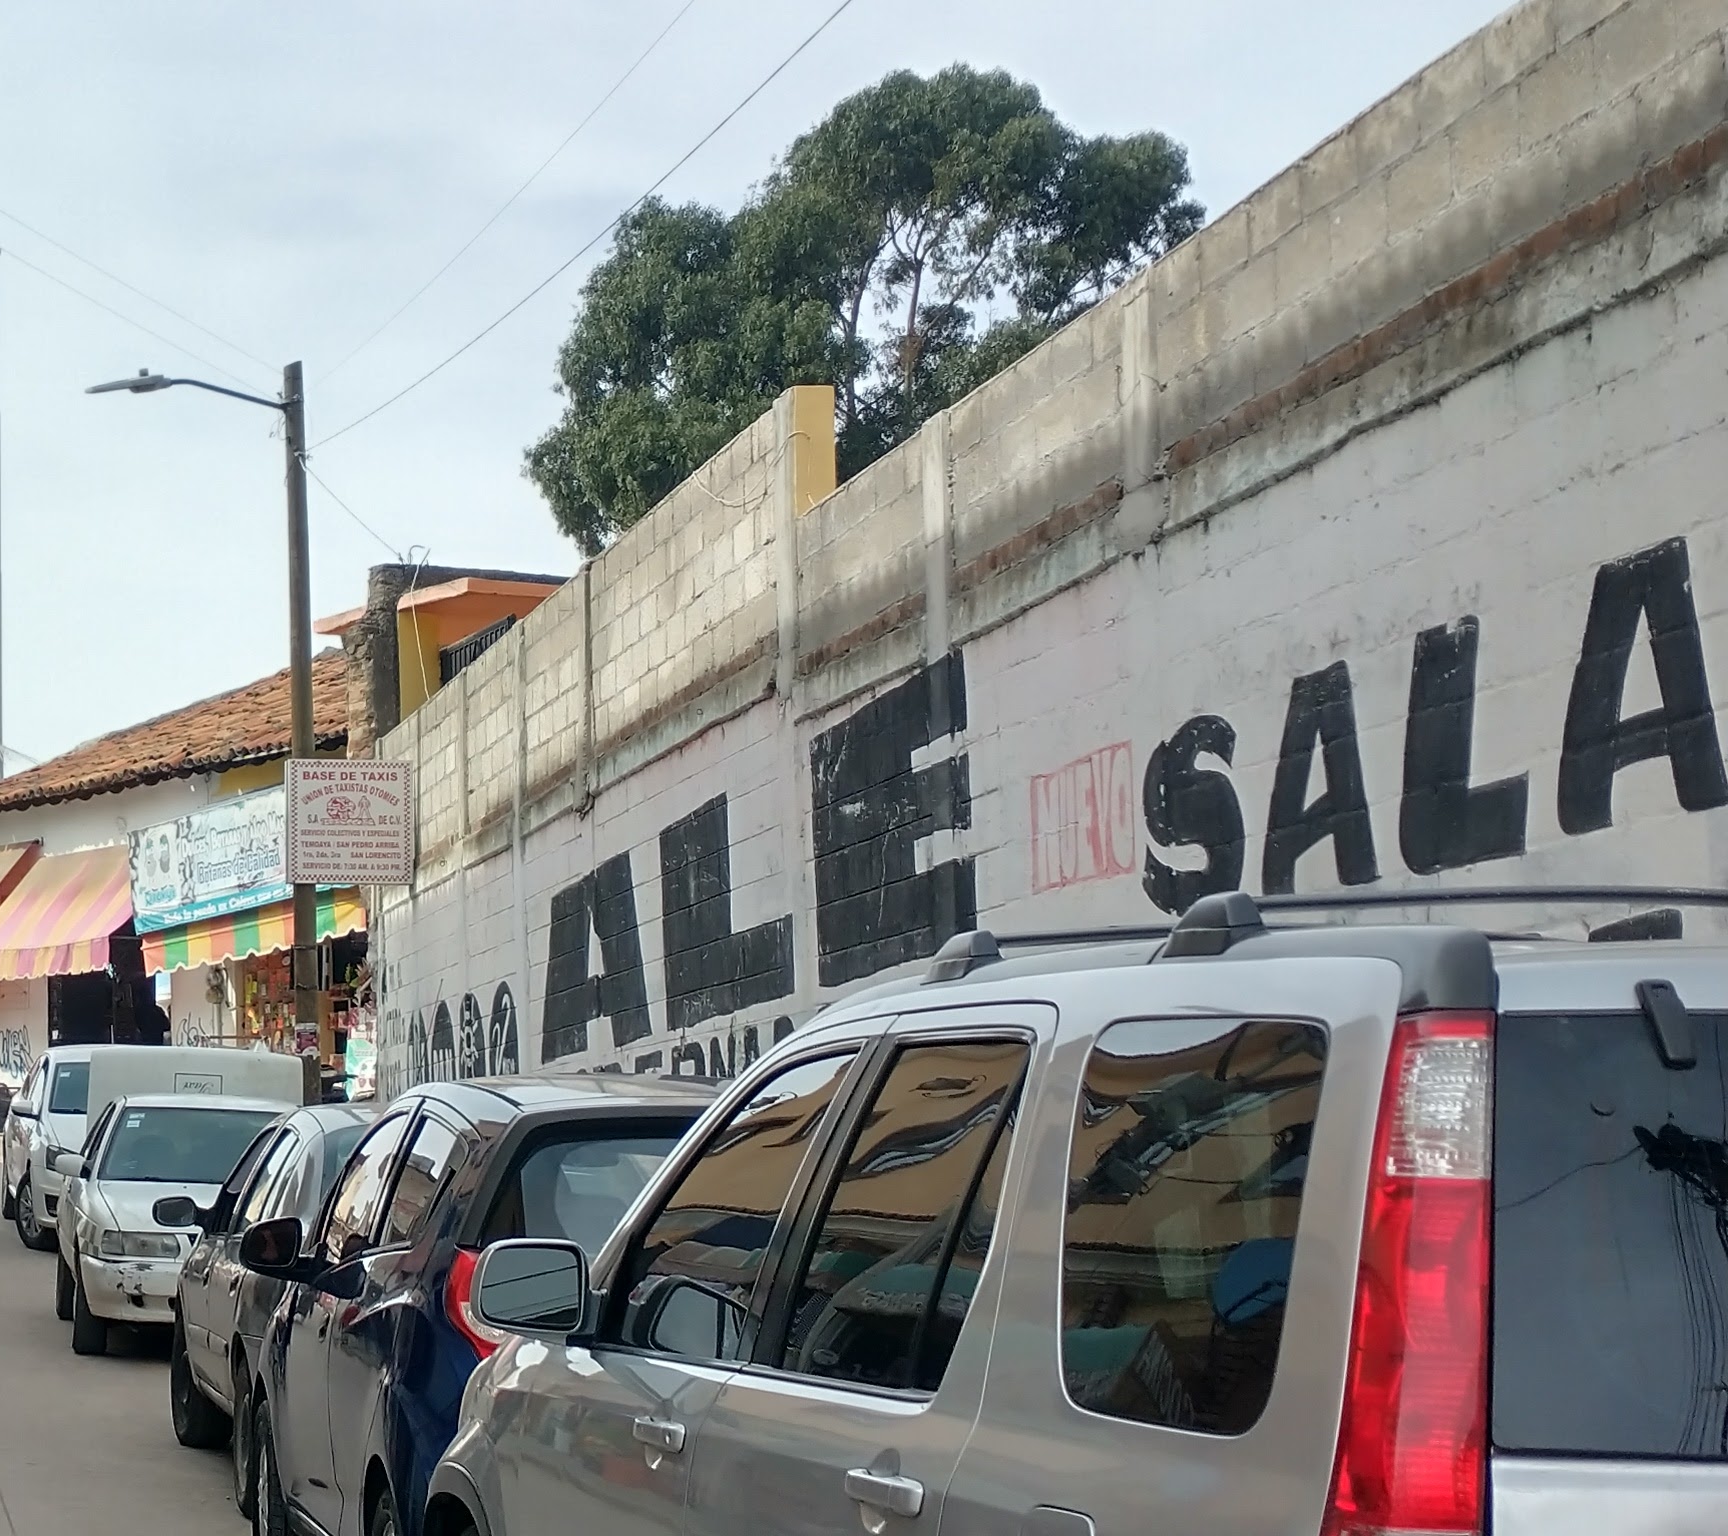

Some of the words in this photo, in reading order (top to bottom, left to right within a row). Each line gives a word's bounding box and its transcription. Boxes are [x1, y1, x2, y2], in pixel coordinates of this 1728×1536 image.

[1142, 535, 1728, 917] SALA
[302, 771, 336, 781] BASE
[340, 771, 357, 781] DE
[361, 771, 398, 781] TAXIS
[301, 790, 324, 805] UNION
[324, 786, 334, 795] DE
[335, 783, 369, 794] TAXISTAS
[369, 786, 400, 806] OTOMIES
[378, 815, 387, 825] DE
[197, 859, 232, 884] Botanas
[233, 853, 245, 876] de
[245, 848, 280, 873] Calidad
[350, 851, 363, 859] SAN
[541, 648, 977, 1064] ALE
